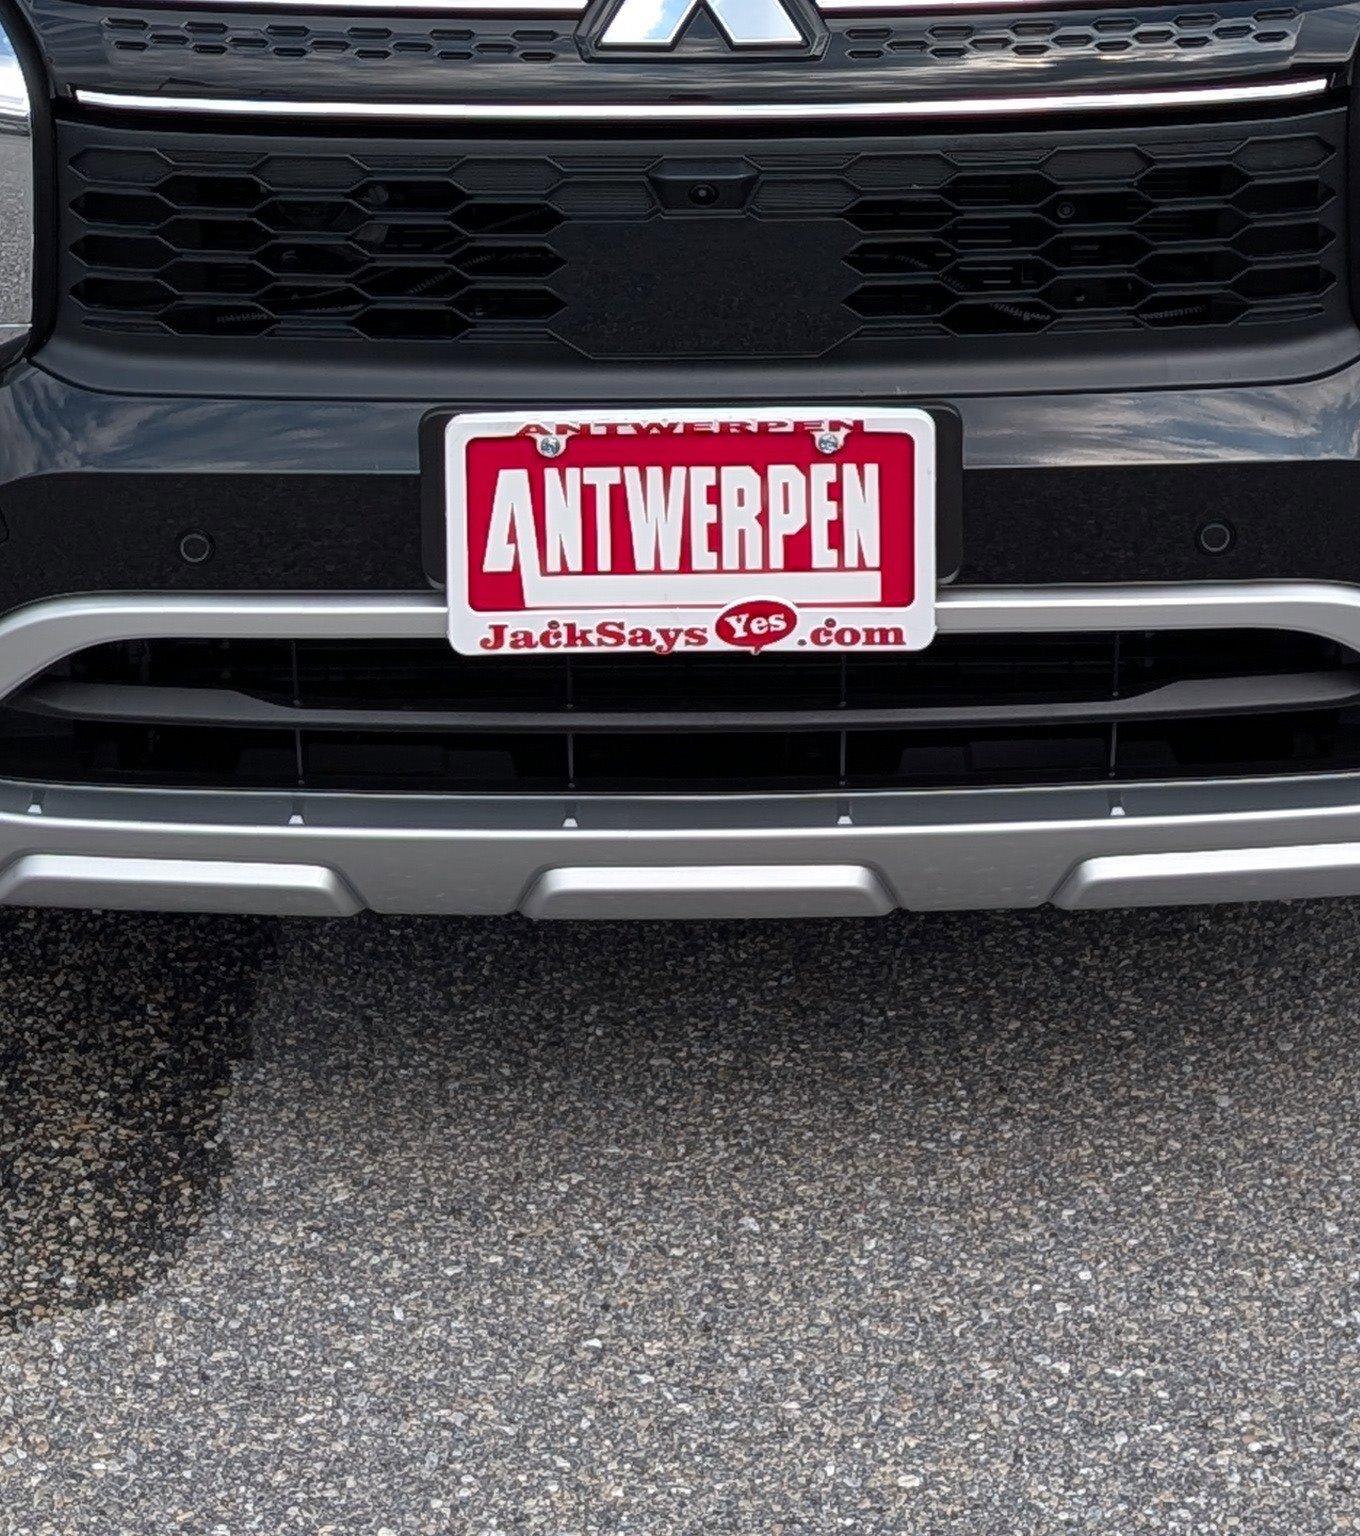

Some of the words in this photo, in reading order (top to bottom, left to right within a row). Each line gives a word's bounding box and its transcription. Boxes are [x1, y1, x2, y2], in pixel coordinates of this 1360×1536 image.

[514, 419, 866, 436] ANTWERPEN
[482, 463, 882, 607] ANTWERPEN
[479, 620, 708, 655] JackSays
[726, 610, 787, 639] Yes
